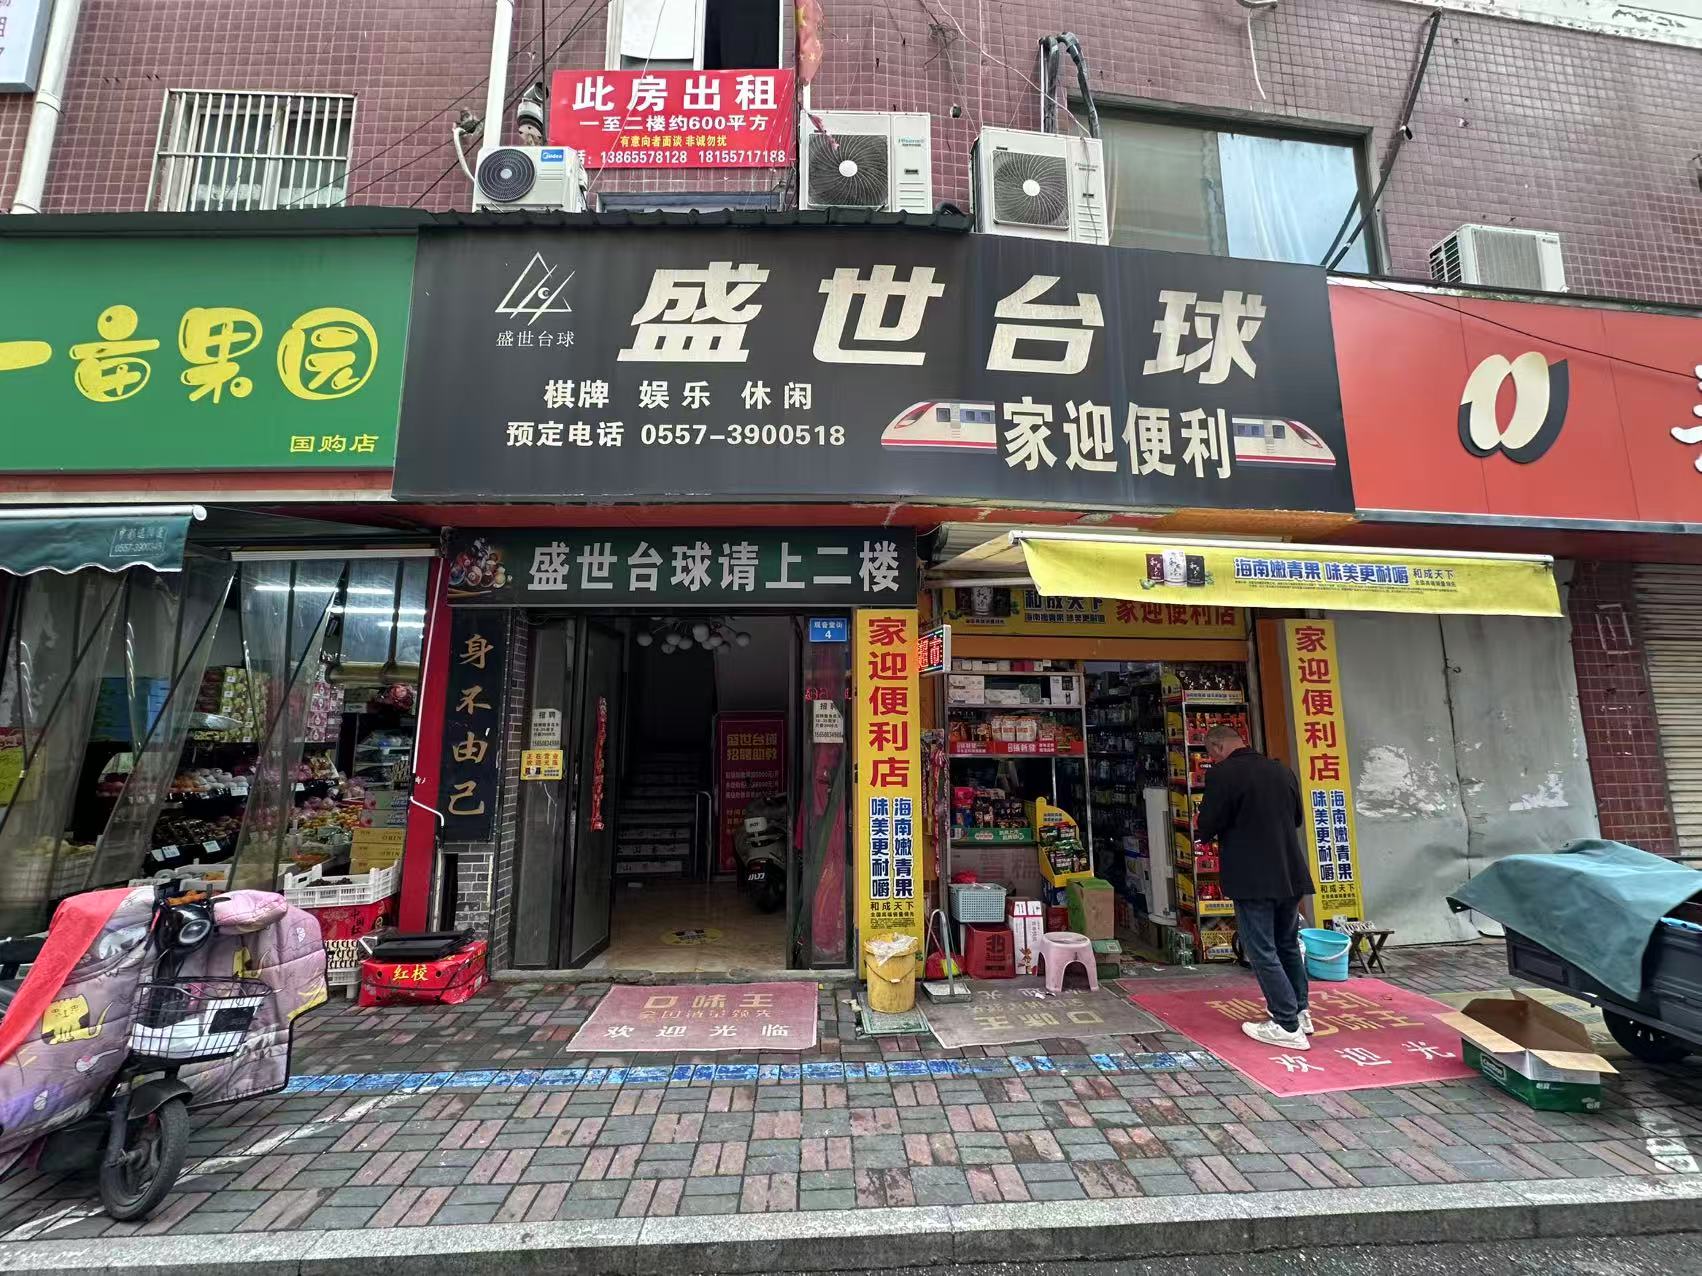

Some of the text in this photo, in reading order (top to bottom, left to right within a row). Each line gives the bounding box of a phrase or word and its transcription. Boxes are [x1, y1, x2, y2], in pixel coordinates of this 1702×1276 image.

[572, 75, 778, 111] 此房出租
[579, 115, 769, 132] 一至二楼约600平方
[620, 134, 728, 147] 有意向者面谈 非诚勿扰
[600, 151, 687, 164] 13865578128
[616, 261, 1267, 385] 盛世台球
[495, 330, 575, 348] 盛世台球
[543, 379, 812, 411] 棋牌 娱乐 休闲
[289, 434, 379, 454] 国购店
[506, 421, 625, 447] 预定电话
[1003, 396, 1234, 479] 家迎便利
[527, 541, 900, 593] 盛世台球请上二楼
[1234, 558, 1410, 585] 海南嫩青果 味美更耐嚼
[1412, 567, 1456, 580] 和成天下
[824, 630, 832, 639] 4
[868, 616, 910, 788] 家迎便利店
[1295, 626, 1340, 782] 家迎便利店
[448, 634, 494, 816] 身不由己
[870, 797, 890, 898] 味美更耐嚼
[894, 797, 913, 898] 海南嫩青果
[1330, 790, 1353, 880] 海南嫩青果
[1320, 883, 1356, 893] 和成天下
[870, 901, 915, 911] 和成天下
[643, 993, 774, 1009] 口味王
[603, 1024, 791, 1038] 欢迎光临
